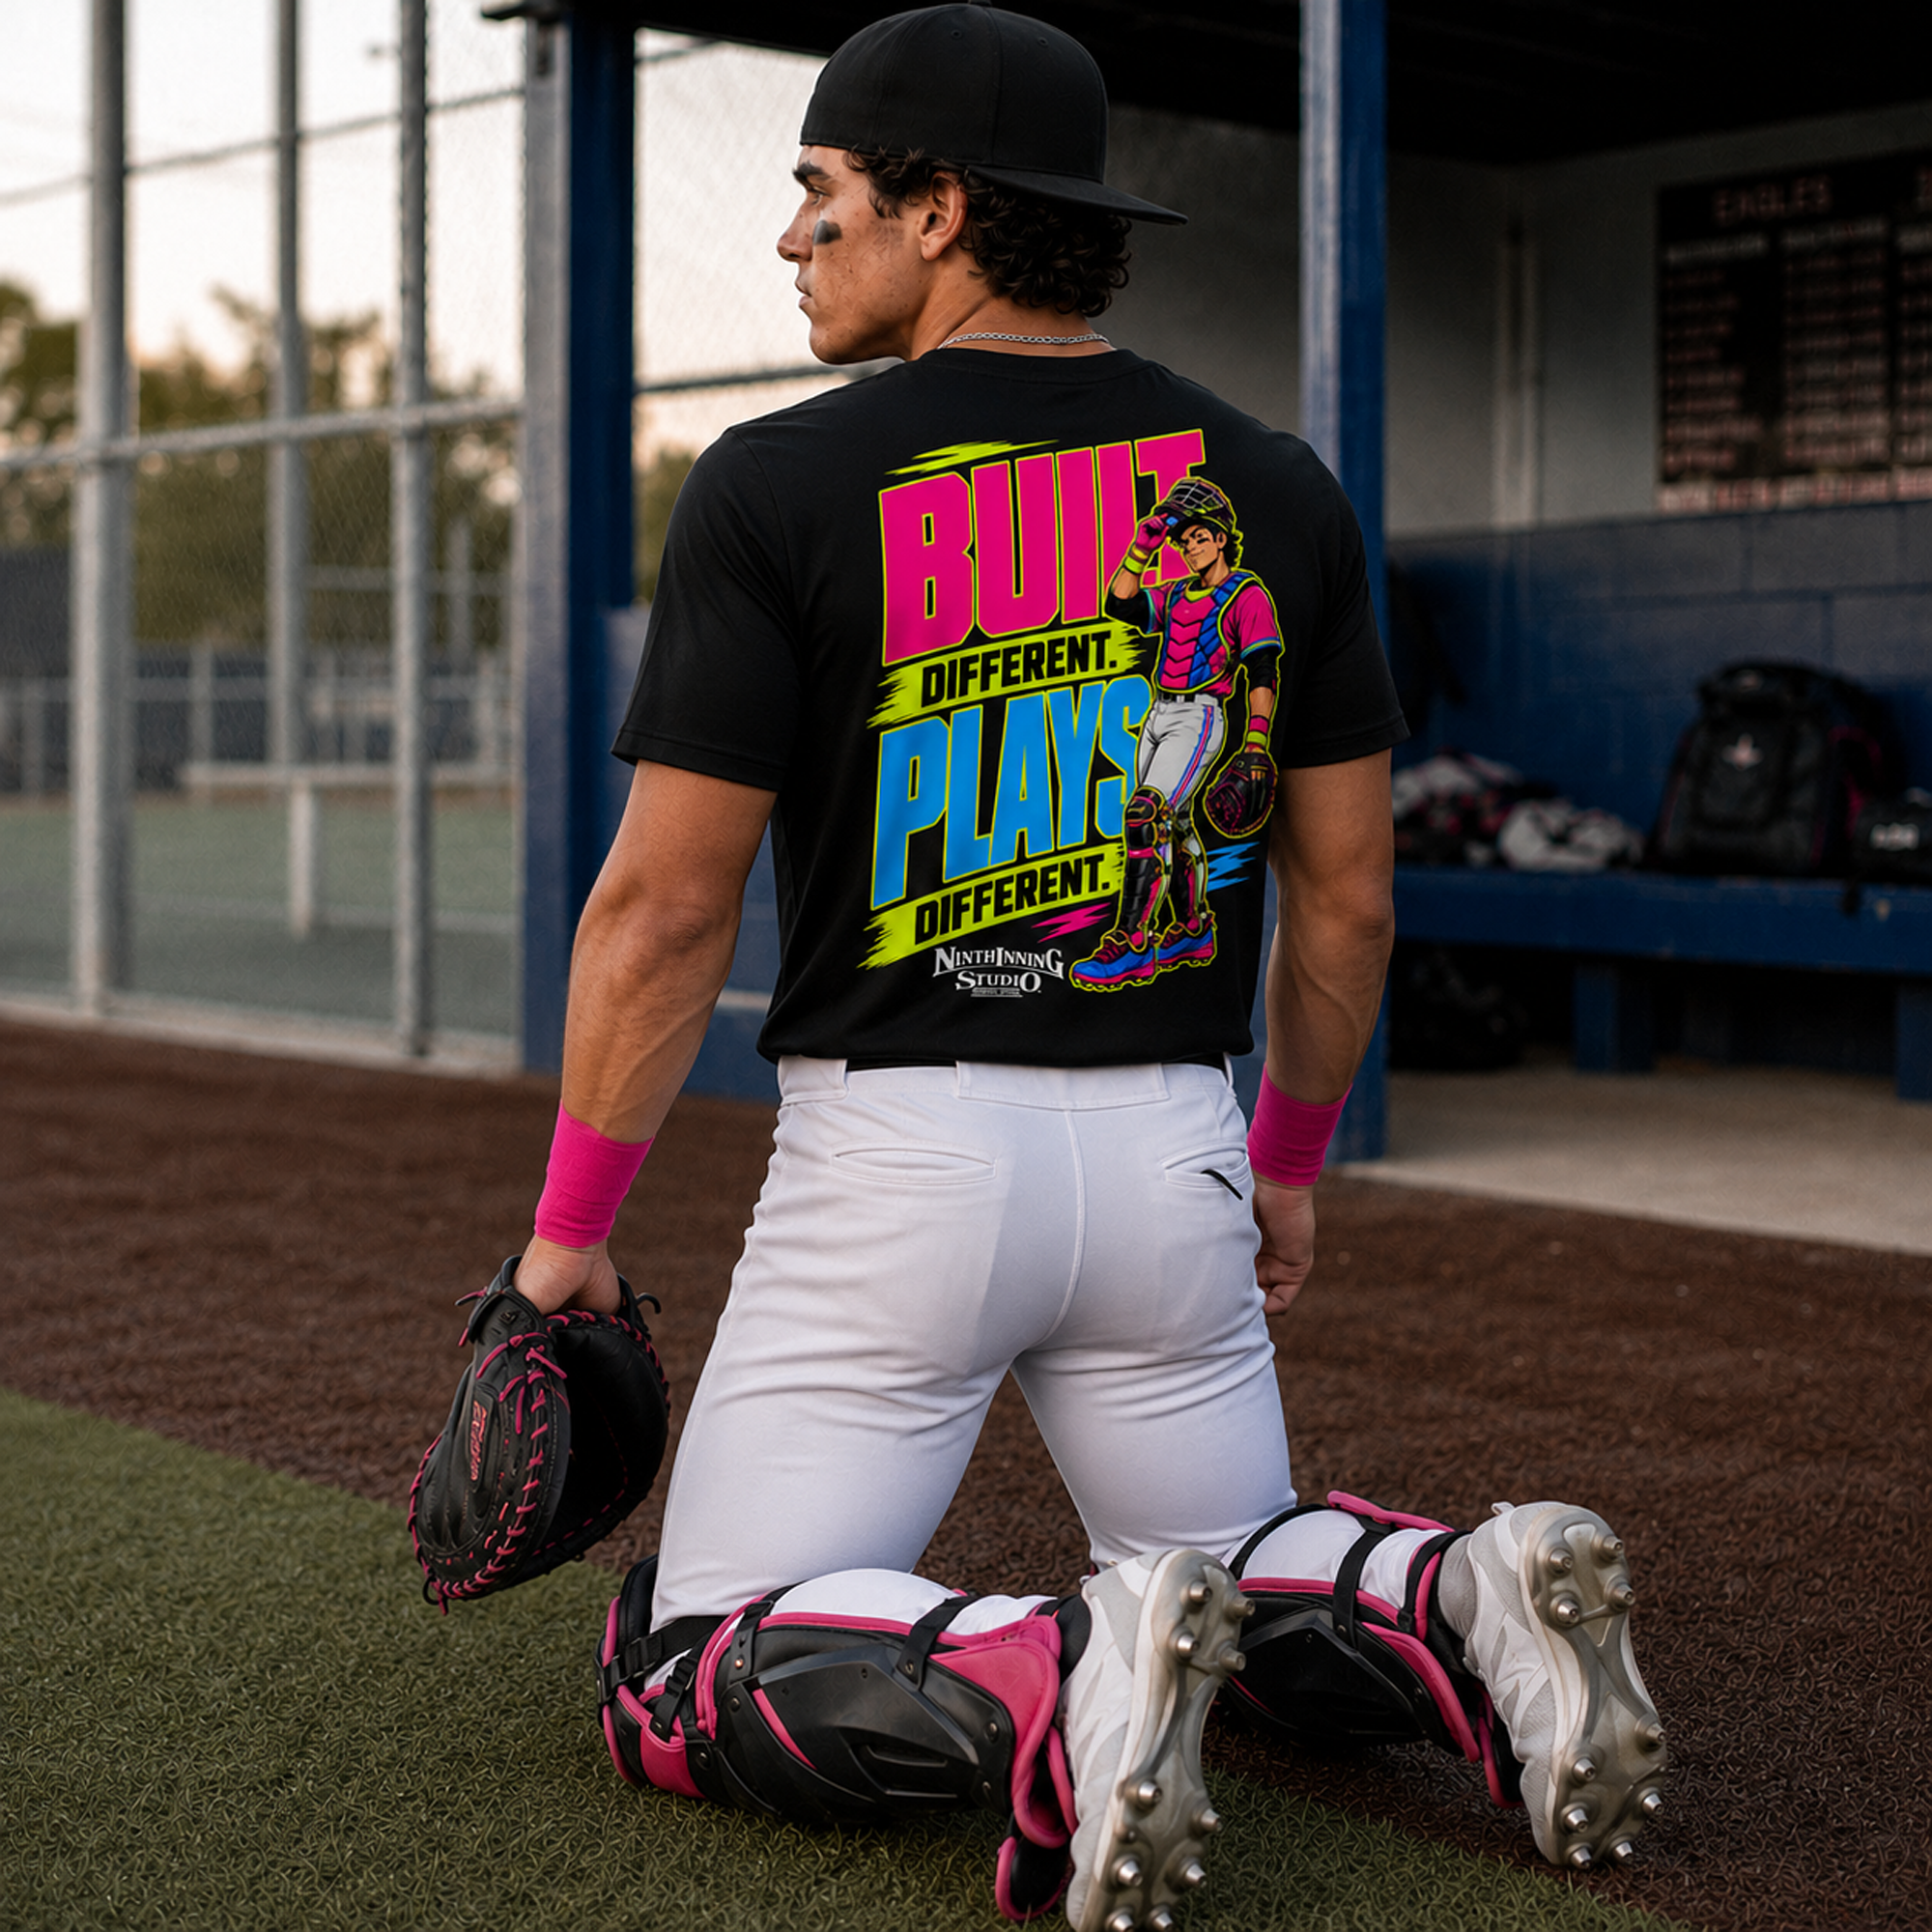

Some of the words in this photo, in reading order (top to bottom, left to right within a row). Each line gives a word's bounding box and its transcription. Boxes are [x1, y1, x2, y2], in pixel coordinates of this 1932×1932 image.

[879, 429, 1206, 667] BUILT
[921, 630, 1118, 709] DIFFERENT.
[870, 674, 1154, 911] PLAYS
[915, 853, 1111, 946] DIFFERENT.
